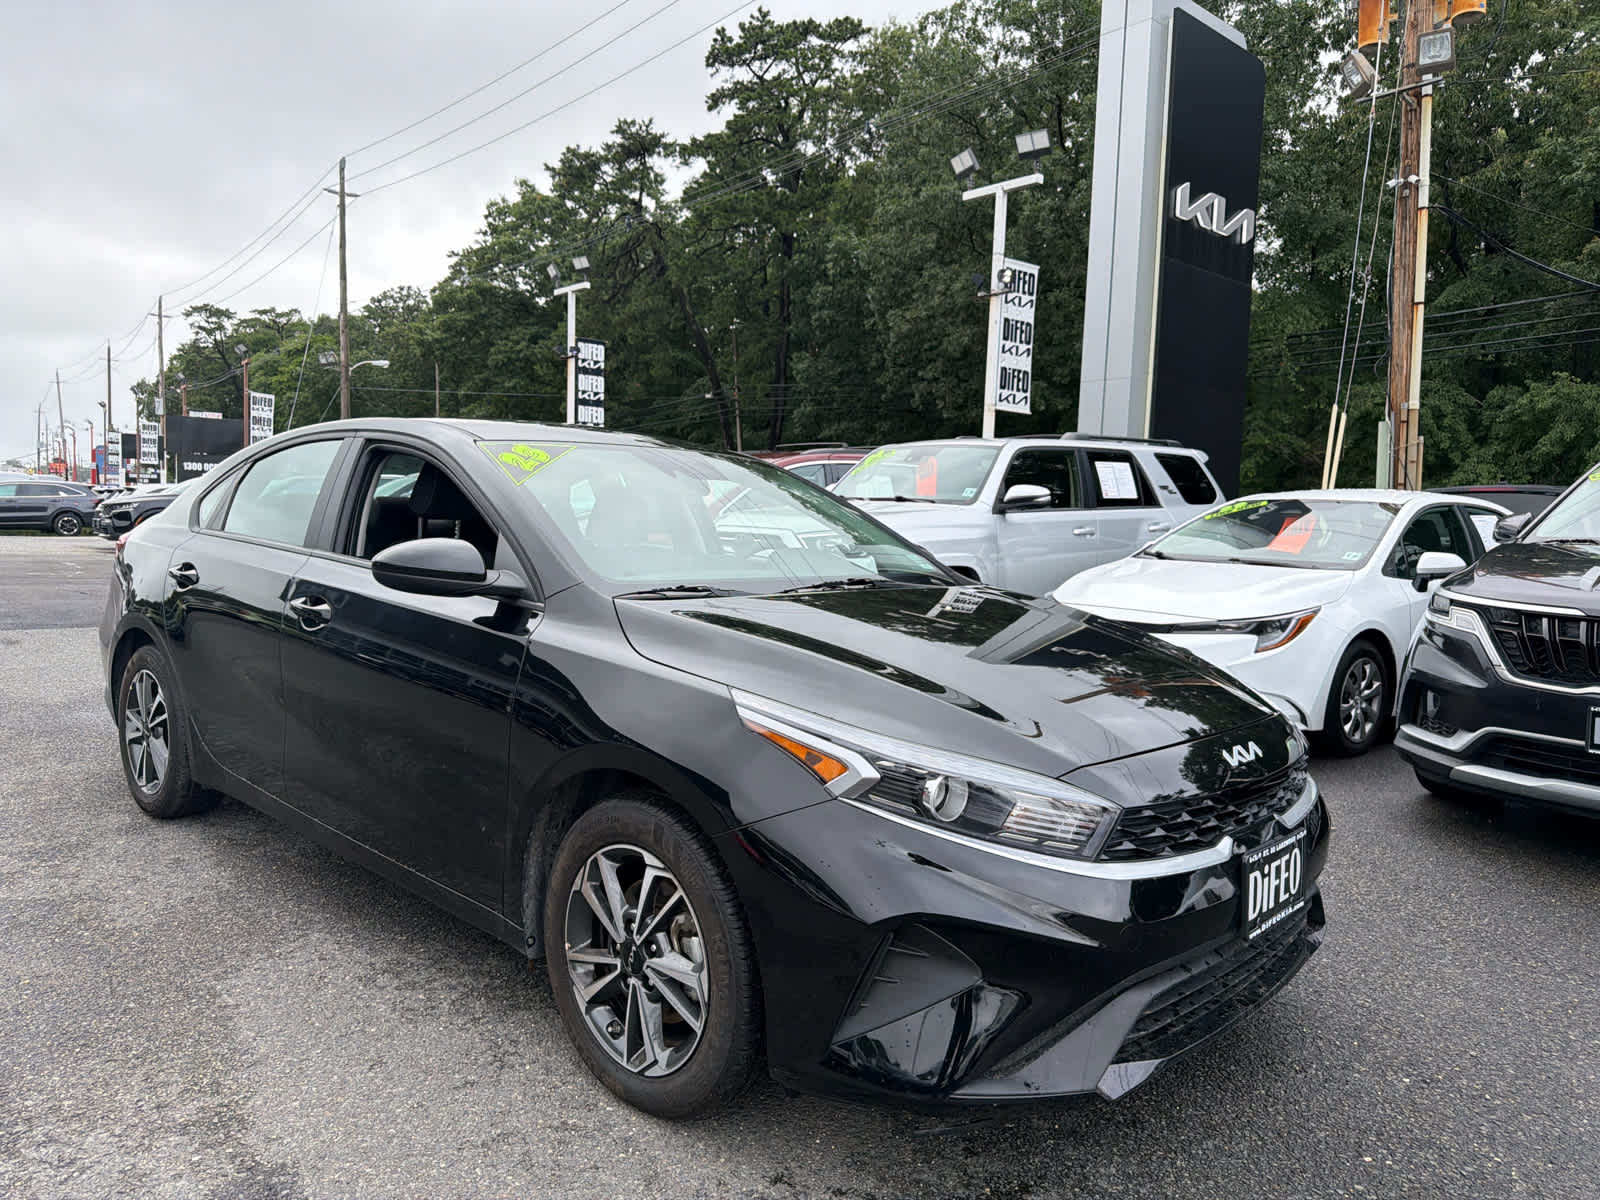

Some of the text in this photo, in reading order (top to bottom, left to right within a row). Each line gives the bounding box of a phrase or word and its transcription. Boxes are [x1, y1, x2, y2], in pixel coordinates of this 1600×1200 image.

[1175, 182, 1255, 244] KIA
[1004, 295, 1034, 309] KIA
[1003, 317, 1032, 345] DiFEO
[1001, 344, 1031, 358] KIA
[1000, 366, 1029, 394] DiFEO
[998, 392, 1028, 406] KIA
[183, 462, 203, 471] 1300
[1222, 740, 1264, 767] KIA
[1248, 847, 1301, 921] DiFEO
